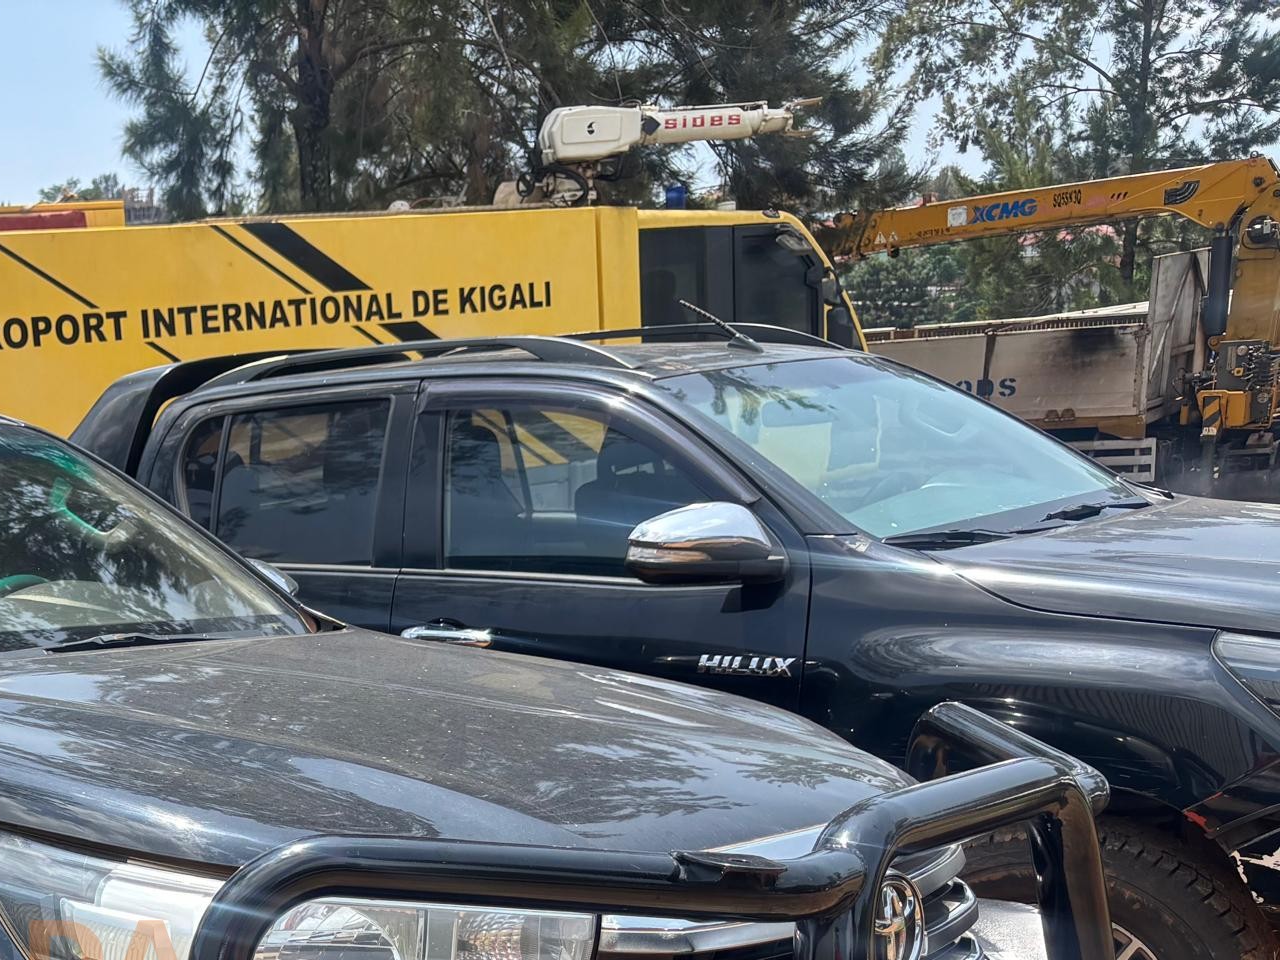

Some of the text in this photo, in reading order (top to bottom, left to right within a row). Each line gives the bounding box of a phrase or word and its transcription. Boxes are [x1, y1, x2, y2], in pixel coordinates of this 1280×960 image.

[664, 113, 741, 129] sides
[972, 198, 1038, 224] XCMG
[140, 292, 402, 338] INTERNATIONAL
[412, 288, 449, 317] DE
[459, 281, 552, 314] KIGALI
[698, 654, 797, 677] HILUX
